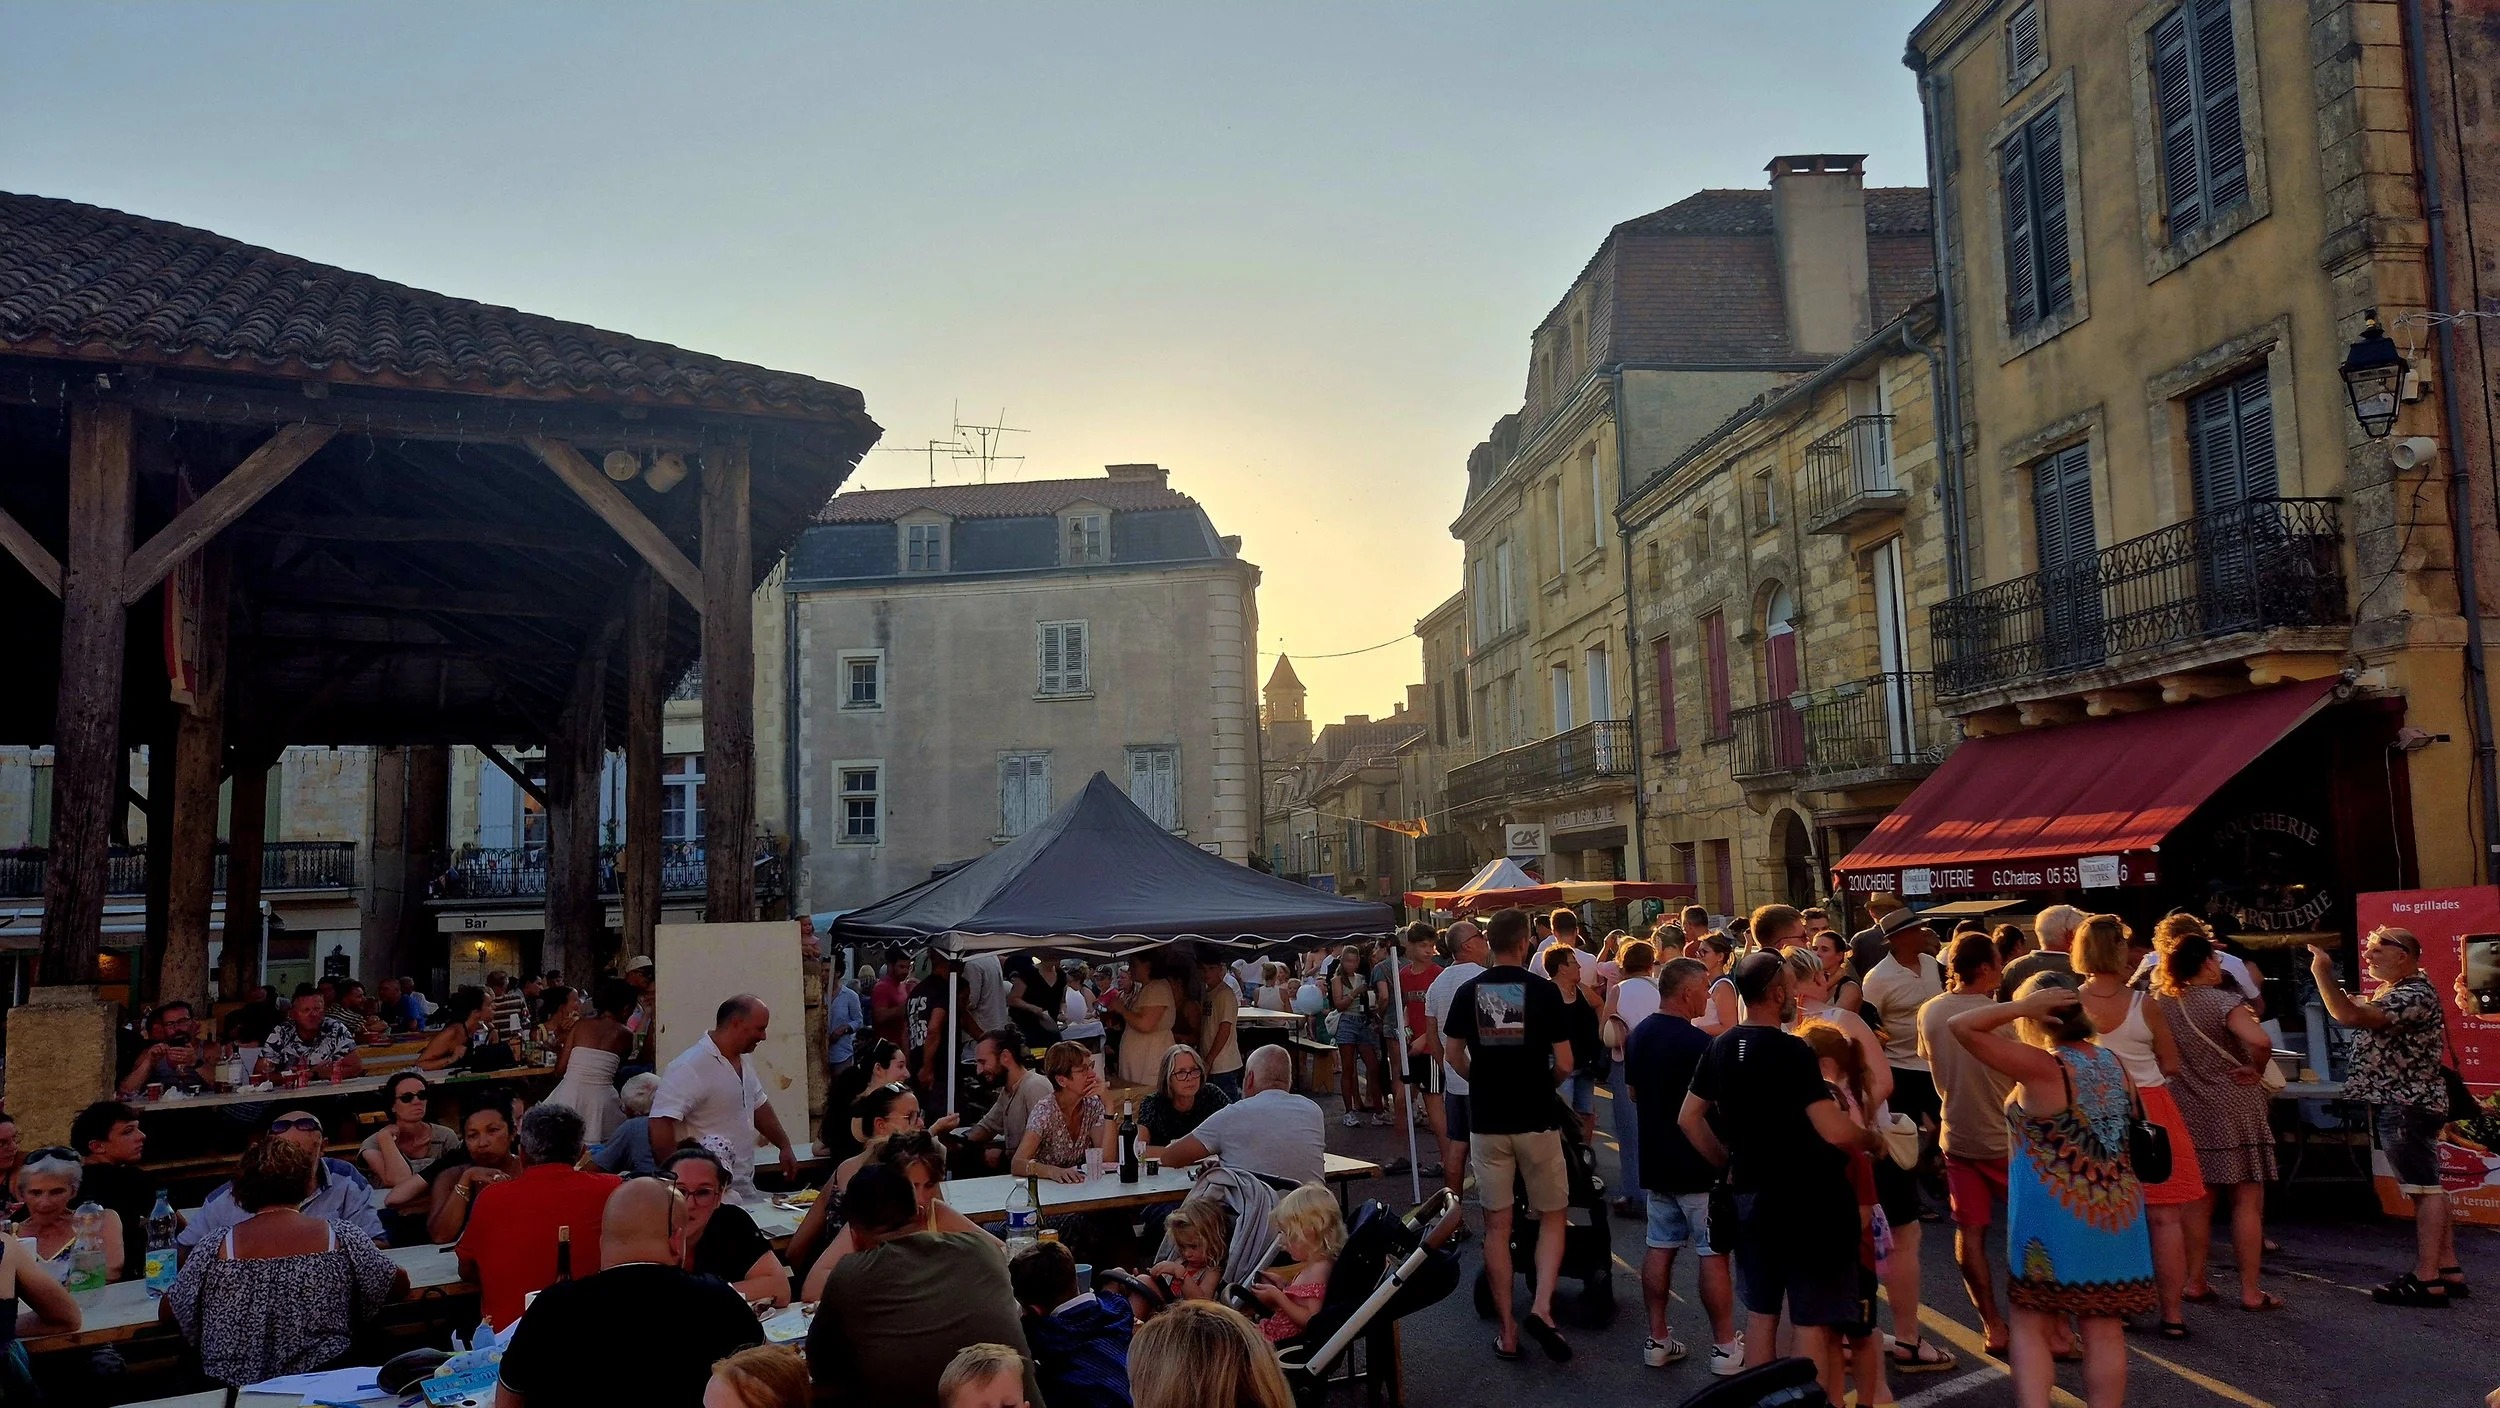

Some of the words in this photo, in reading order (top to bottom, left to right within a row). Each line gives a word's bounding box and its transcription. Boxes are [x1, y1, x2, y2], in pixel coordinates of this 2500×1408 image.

[1929, 868, 1975, 889] CUTERIE
[1992, 870, 2042, 886] G.Chatras
[2046, 868, 2061, 884] 05
[2063, 866, 2078, 883] 53
[2119, 864, 2129, 881] 6
[2392, 902, 2412, 913] Nos
[2414, 900, 2460, 914] grillades
[464, 918, 488, 929] Bar
